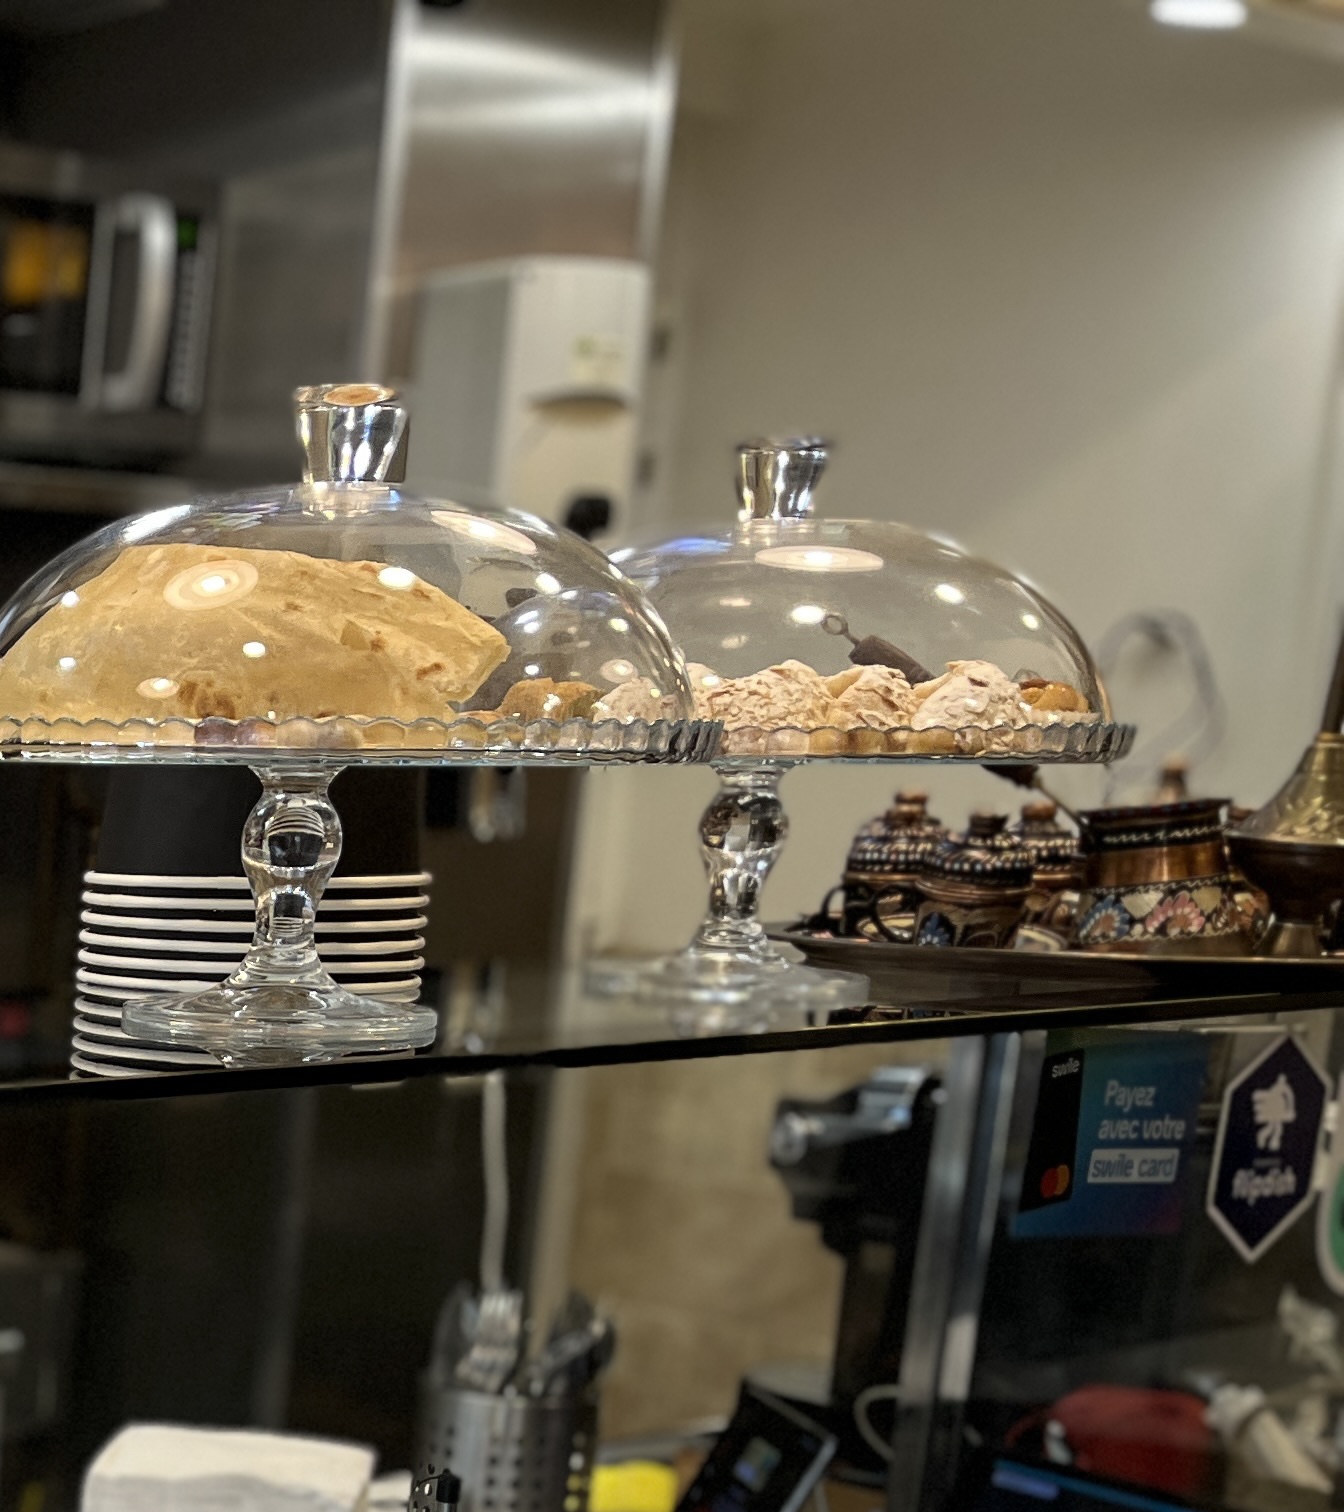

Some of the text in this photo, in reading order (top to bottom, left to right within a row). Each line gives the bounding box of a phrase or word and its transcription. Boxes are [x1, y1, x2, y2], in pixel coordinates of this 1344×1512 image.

[1104, 1079, 1156, 1113] Payez
[1098, 1113, 1186, 1140] avec votre
[1091, 1154, 1175, 1178] swile card
